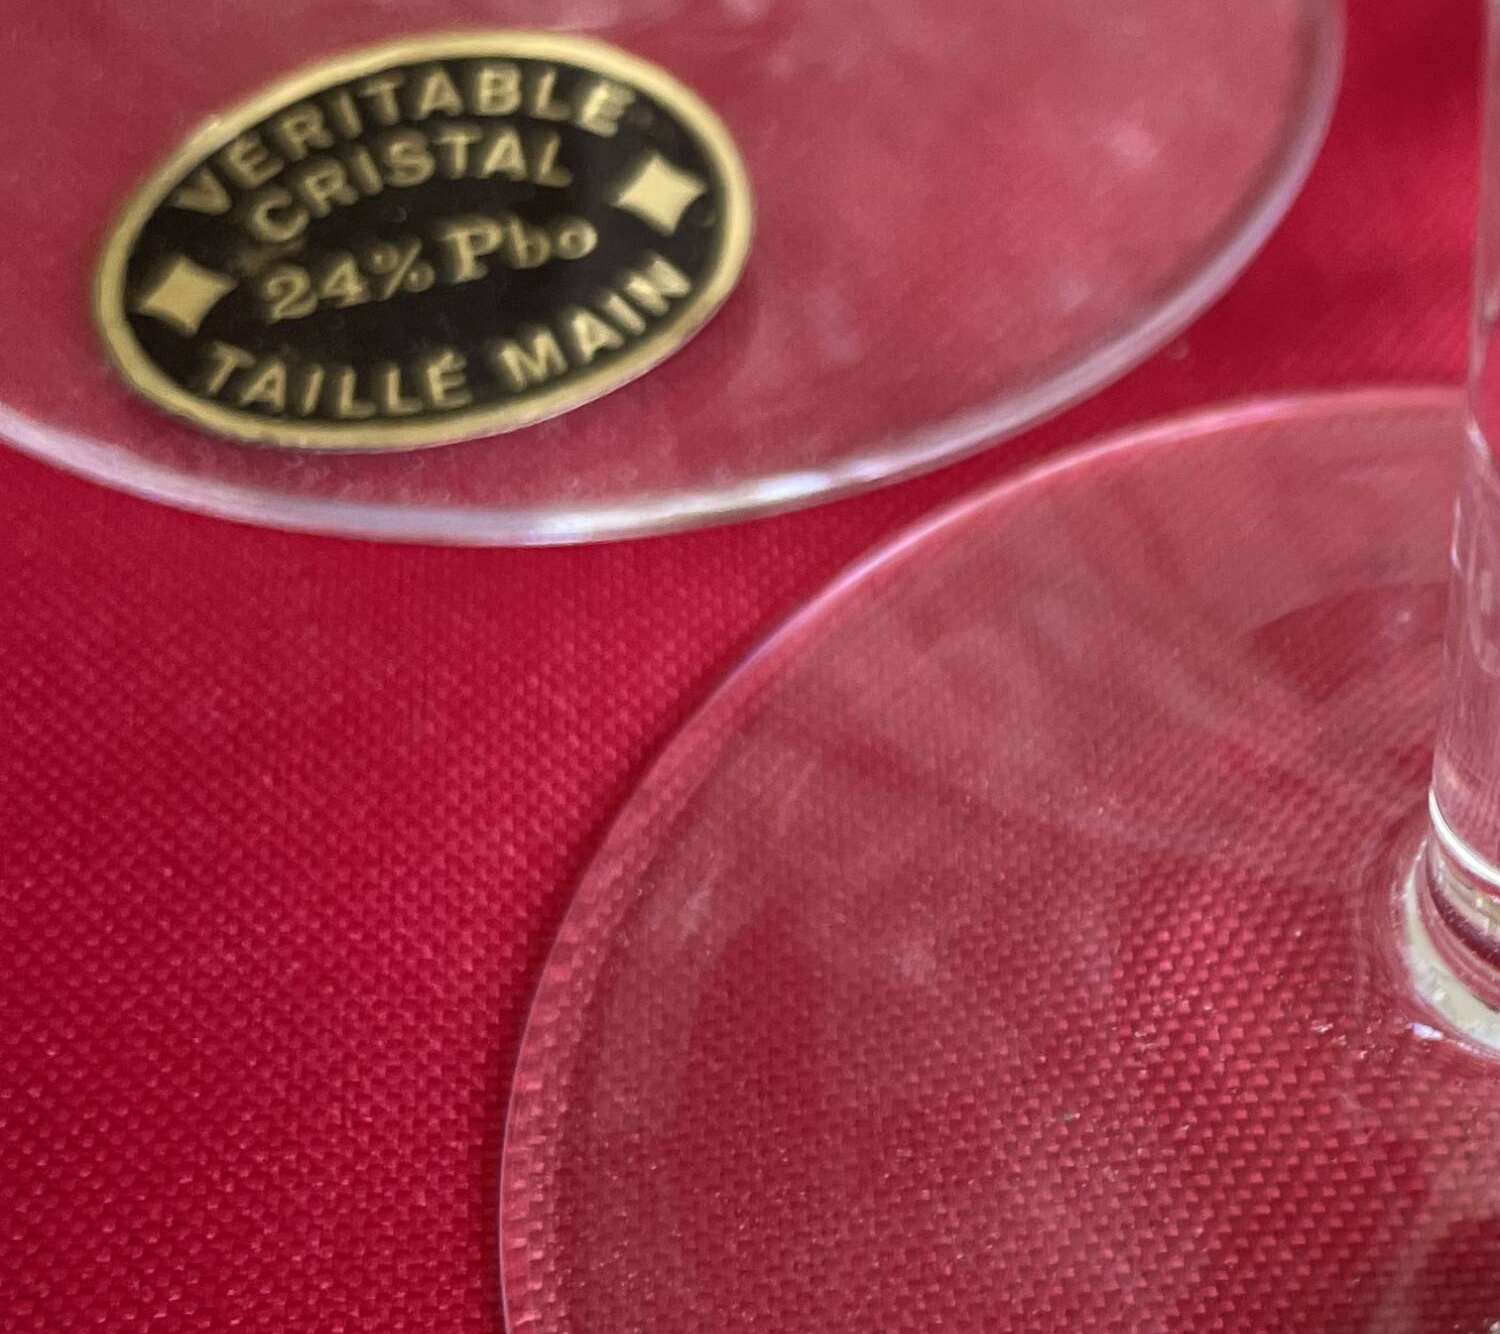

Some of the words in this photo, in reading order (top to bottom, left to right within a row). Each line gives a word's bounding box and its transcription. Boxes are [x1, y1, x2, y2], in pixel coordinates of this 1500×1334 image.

[251, 123, 573, 242] CRISTAL
[263, 238, 435, 324] 24%
[440, 214, 599, 284] Pbo
[208, 340, 472, 417] TAILLÉ
[500, 254, 690, 393] MAIN
